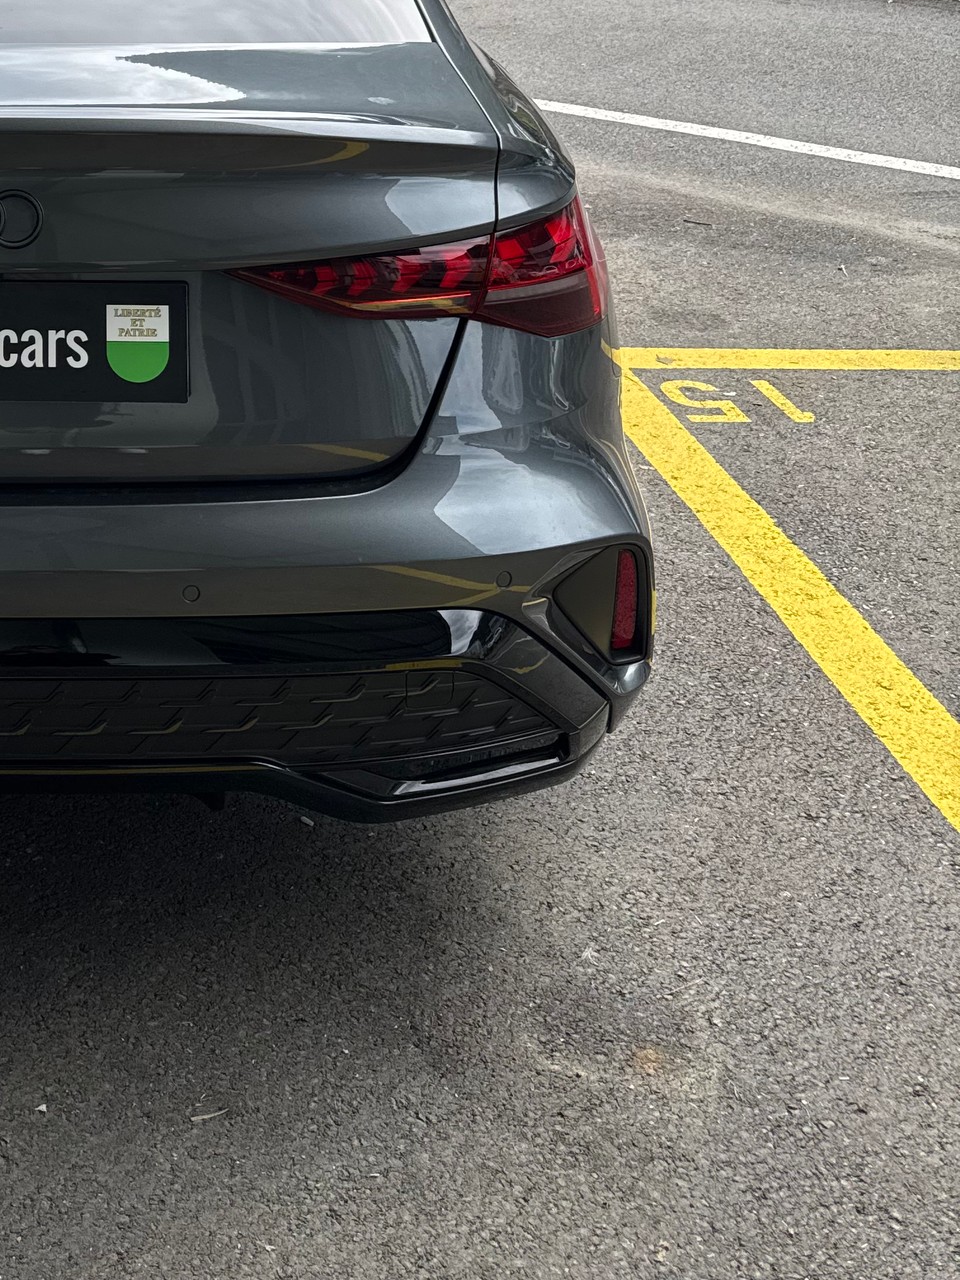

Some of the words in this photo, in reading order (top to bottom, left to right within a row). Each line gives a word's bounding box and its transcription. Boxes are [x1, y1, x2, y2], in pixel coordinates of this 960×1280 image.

[113, 307, 162, 318] LIBERTÉ
[130, 318, 146, 328] ET
[118, 327, 158, 338] PATRIE
[659, 379, 816, 423] 15
